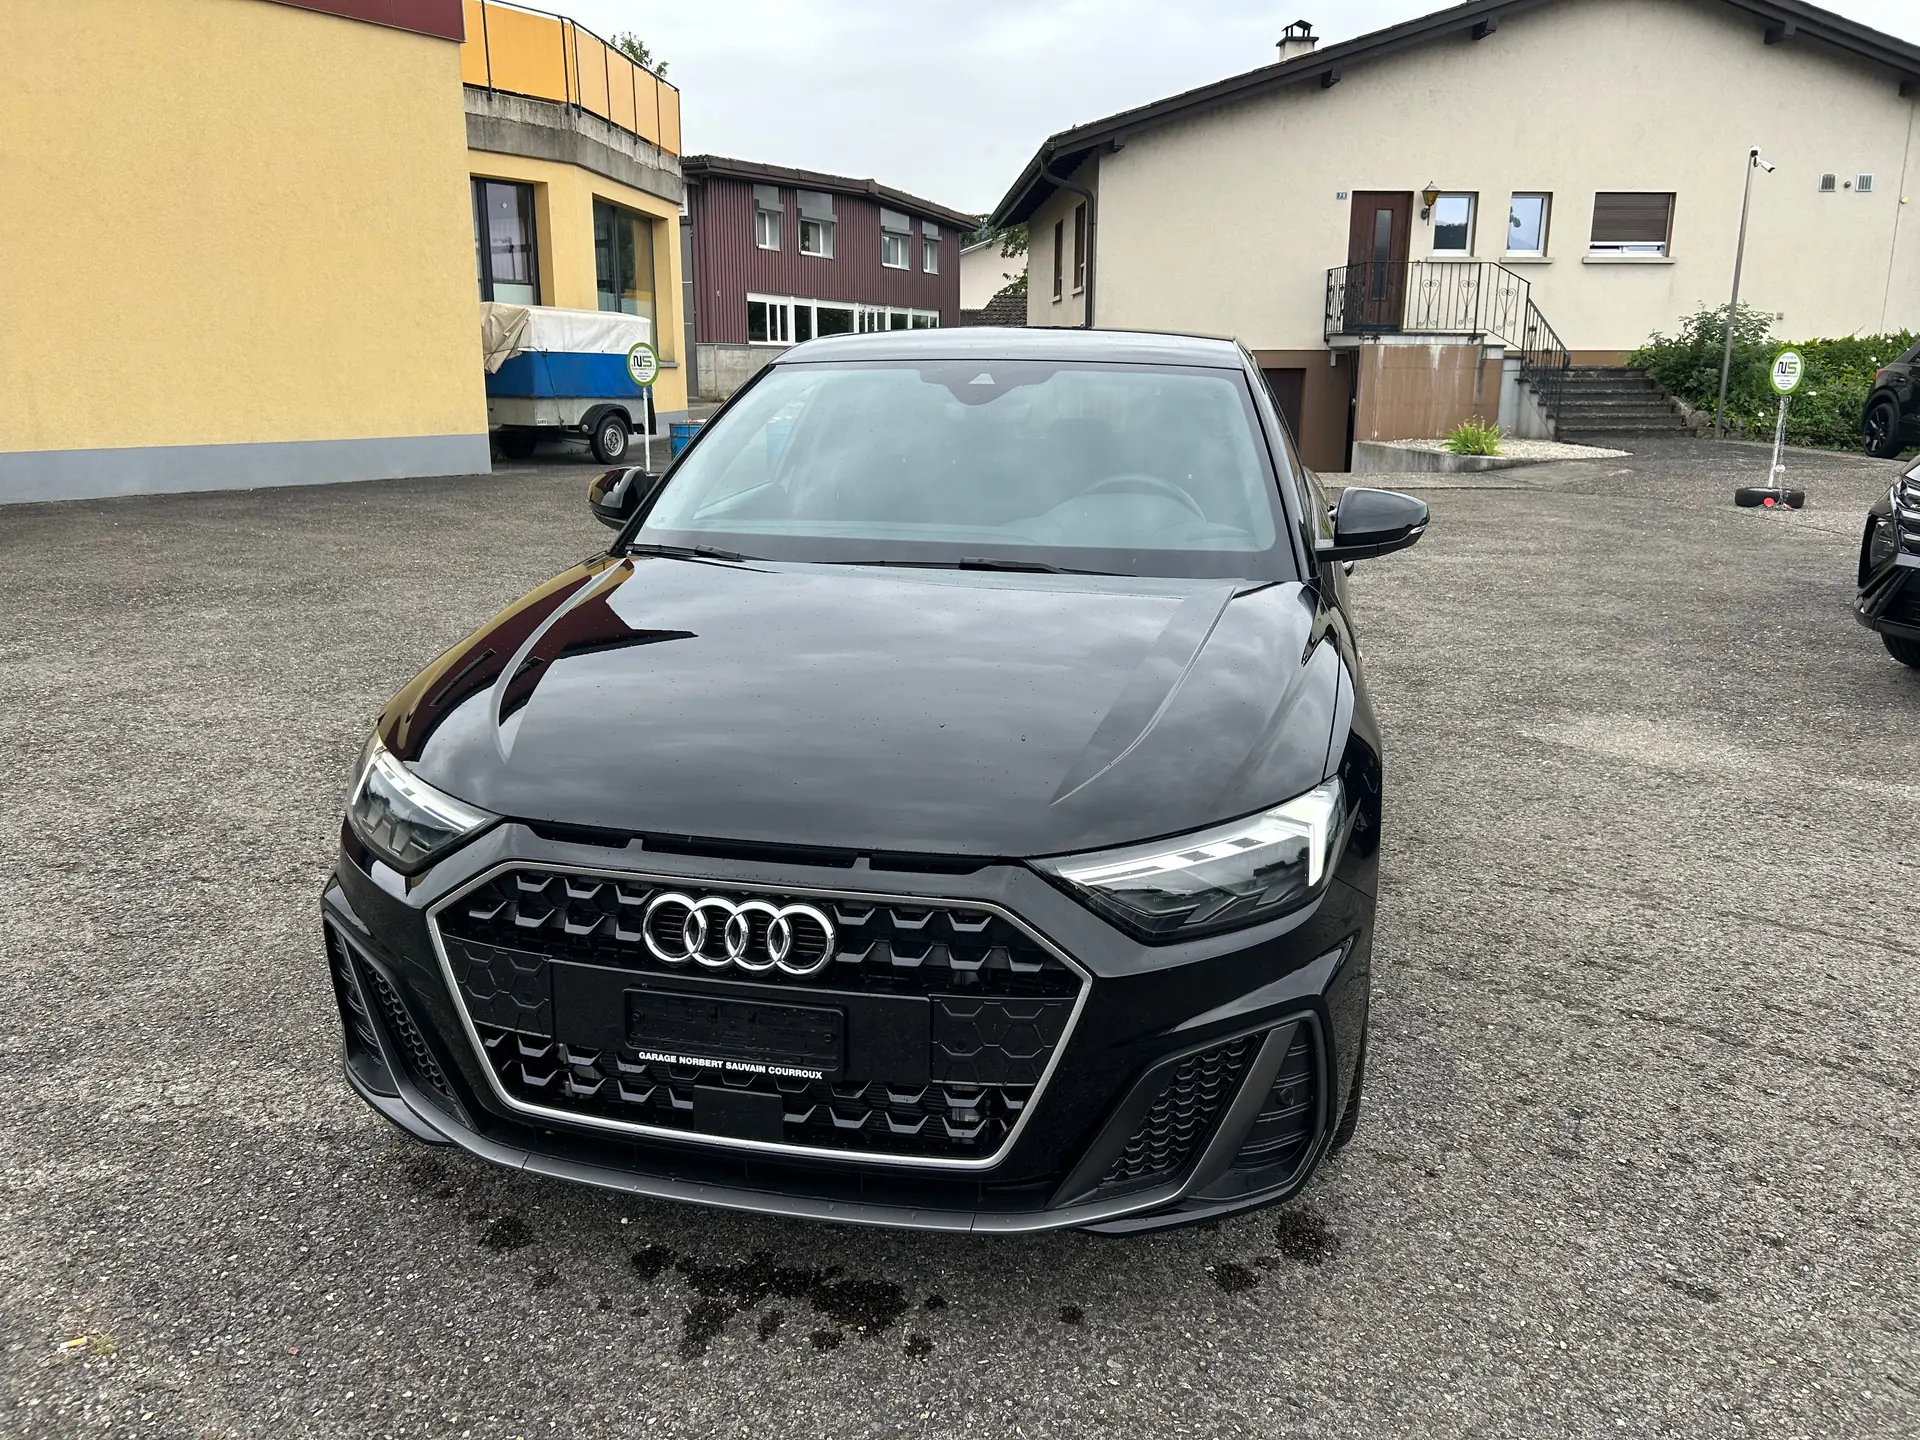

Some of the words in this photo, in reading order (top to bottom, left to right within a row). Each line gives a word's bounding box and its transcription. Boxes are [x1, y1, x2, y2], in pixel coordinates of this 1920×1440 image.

[633, 355, 652, 367] NS
[1777, 361, 1798, 374] NS
[638, 1051, 677, 1063] GARAGE
[679, 1056, 724, 1069] NORBERT
[725, 1061, 766, 1074] SAUVAIN
[768, 1066, 823, 1080] COURROUX
